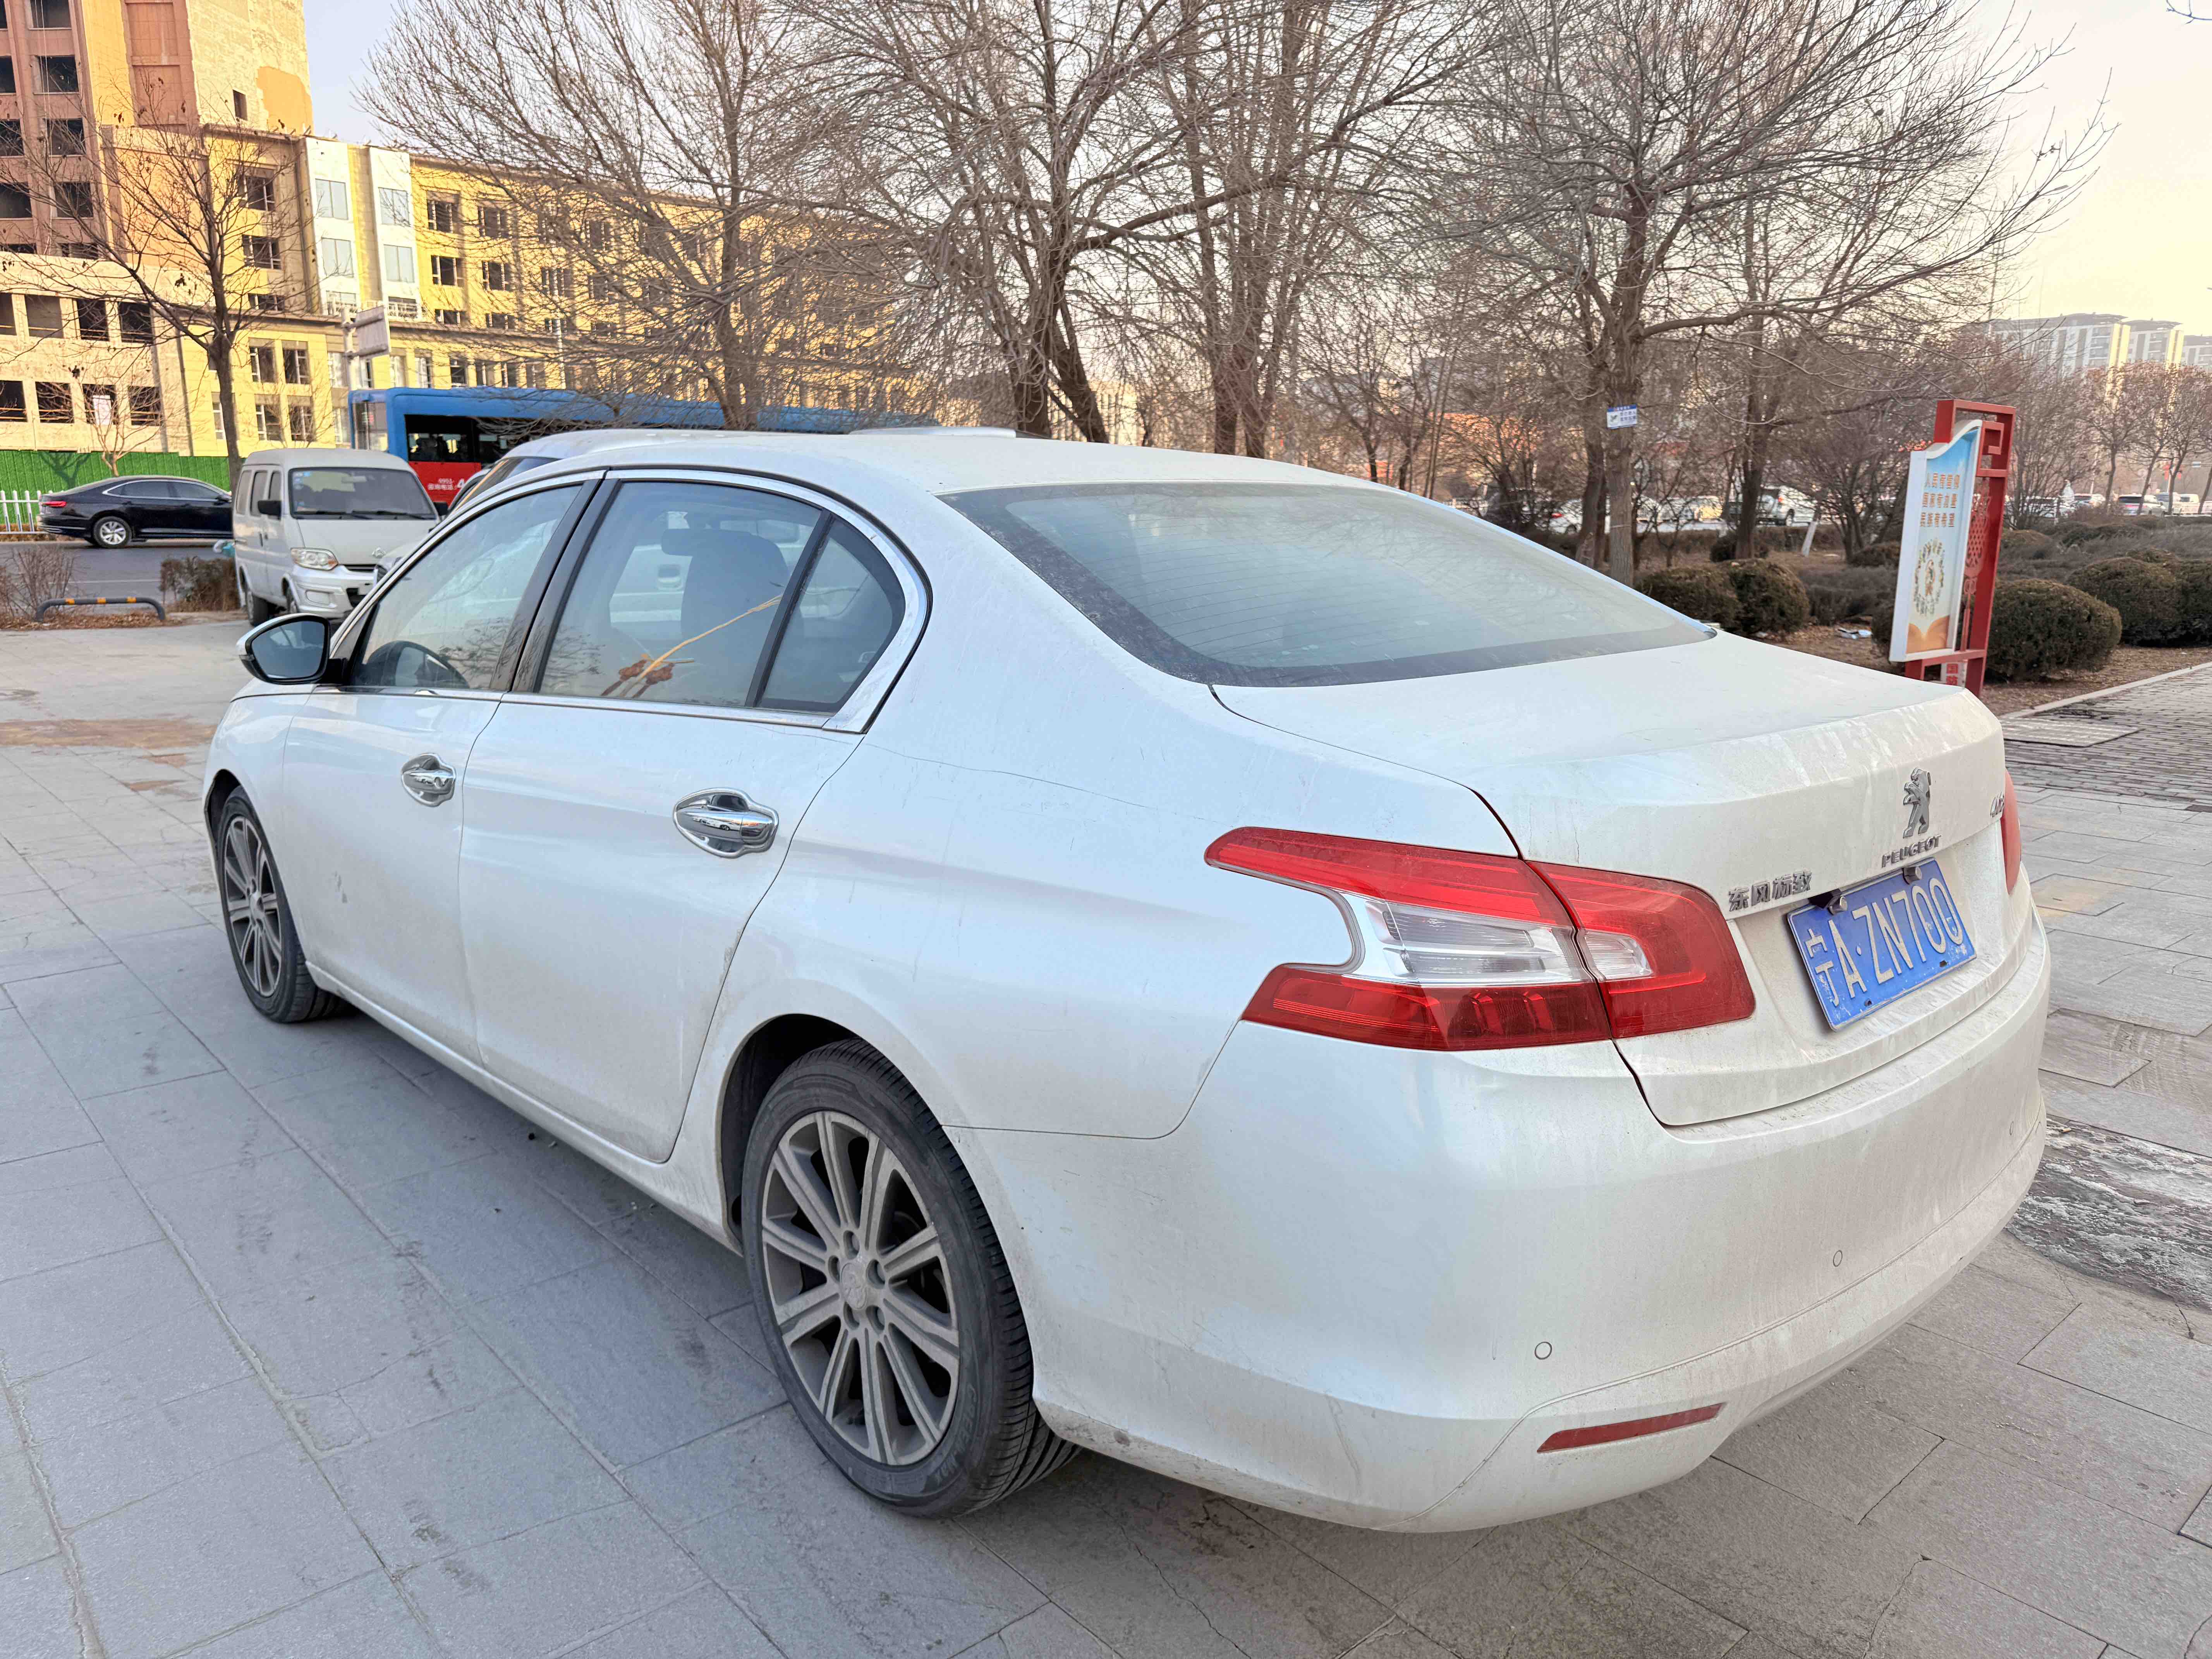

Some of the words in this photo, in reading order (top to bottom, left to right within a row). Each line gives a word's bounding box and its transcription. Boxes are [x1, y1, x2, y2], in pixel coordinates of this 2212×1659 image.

[1882, 835, 1941, 868] PEUGEOT
[1729, 869, 1812, 912] 东风标致
